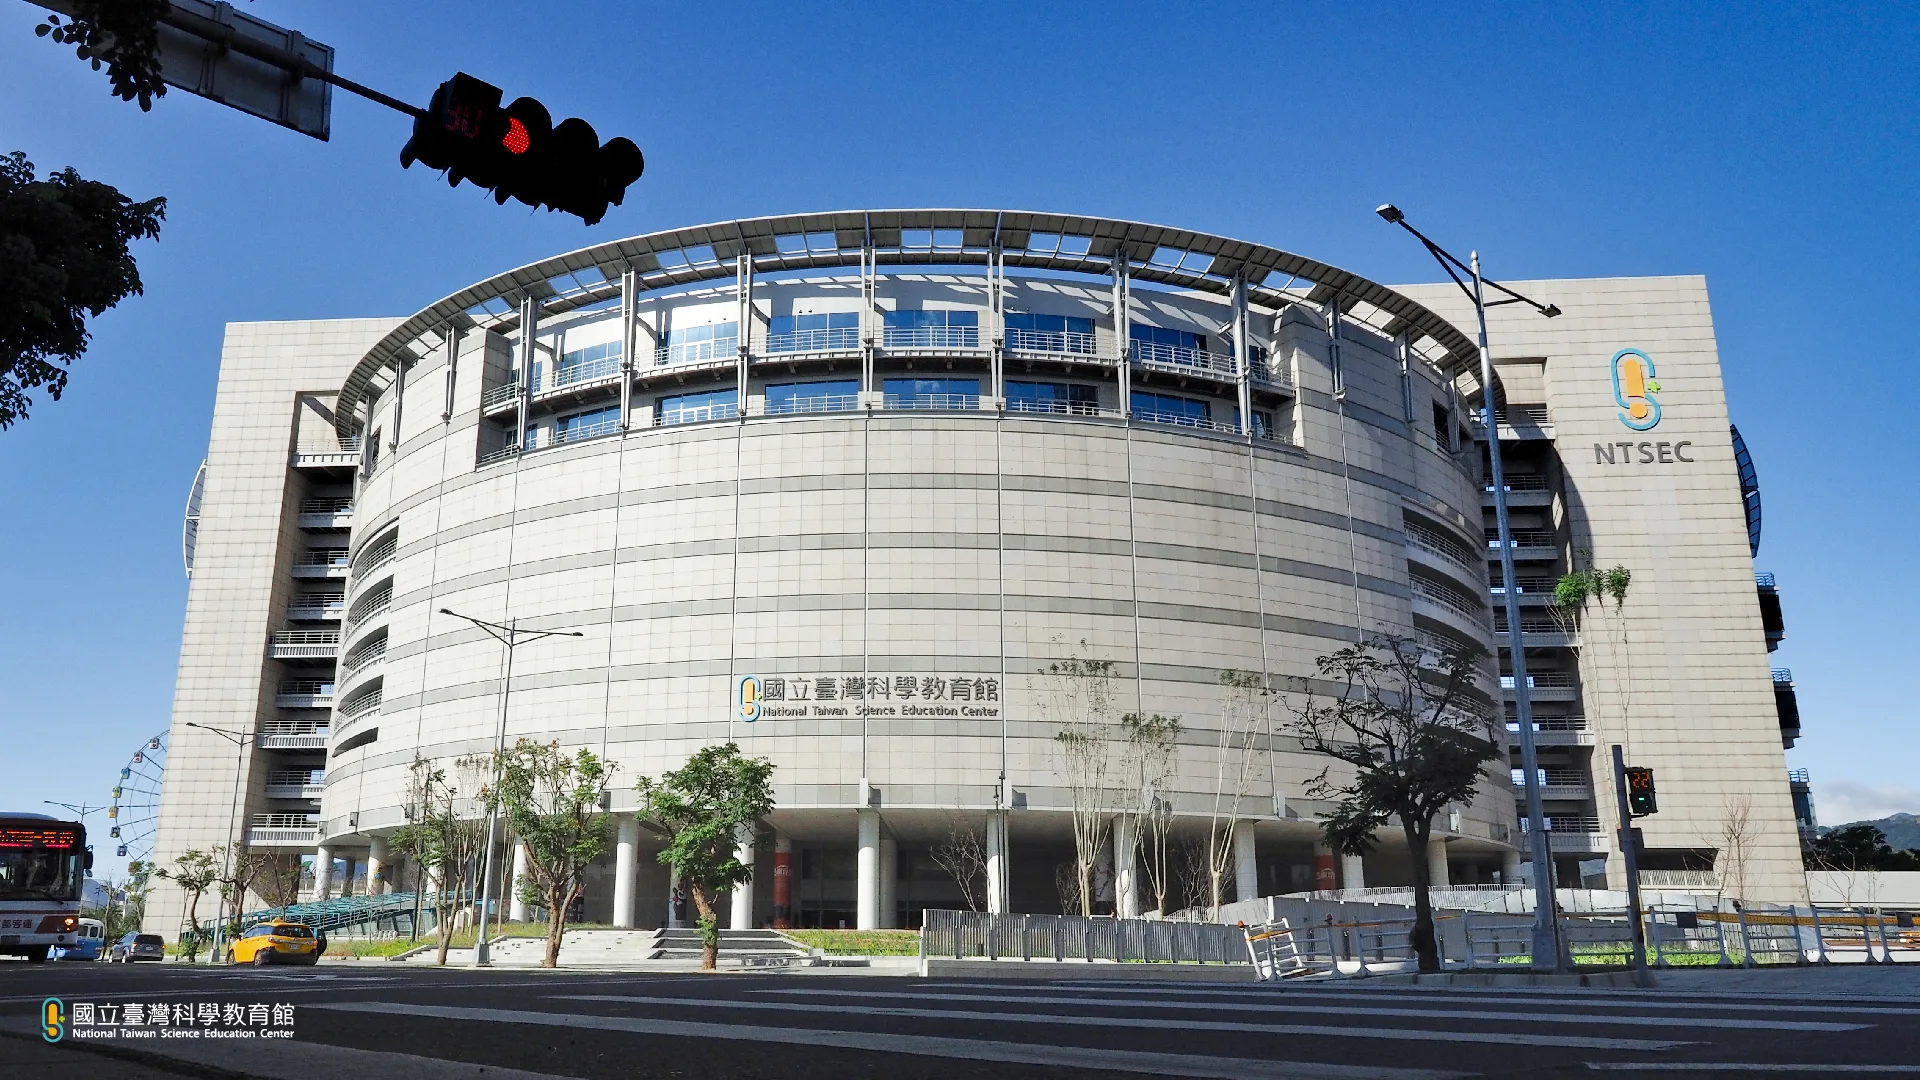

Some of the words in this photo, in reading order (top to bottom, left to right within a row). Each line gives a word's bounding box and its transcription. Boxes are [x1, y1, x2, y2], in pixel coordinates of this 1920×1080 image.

[1594, 441, 1694, 464] NTSEC
[763, 676, 999, 701] 國立臺灣科學教育館
[763, 706, 807, 716] National
[812, 706, 848, 716] Taiwan
[855, 705, 896, 716] Science
[902, 705, 958, 716] Education
[961, 706, 999, 717] Center
[1633, 772, 1649, 788] 22
[0, 919, 33, 929] 都客運
